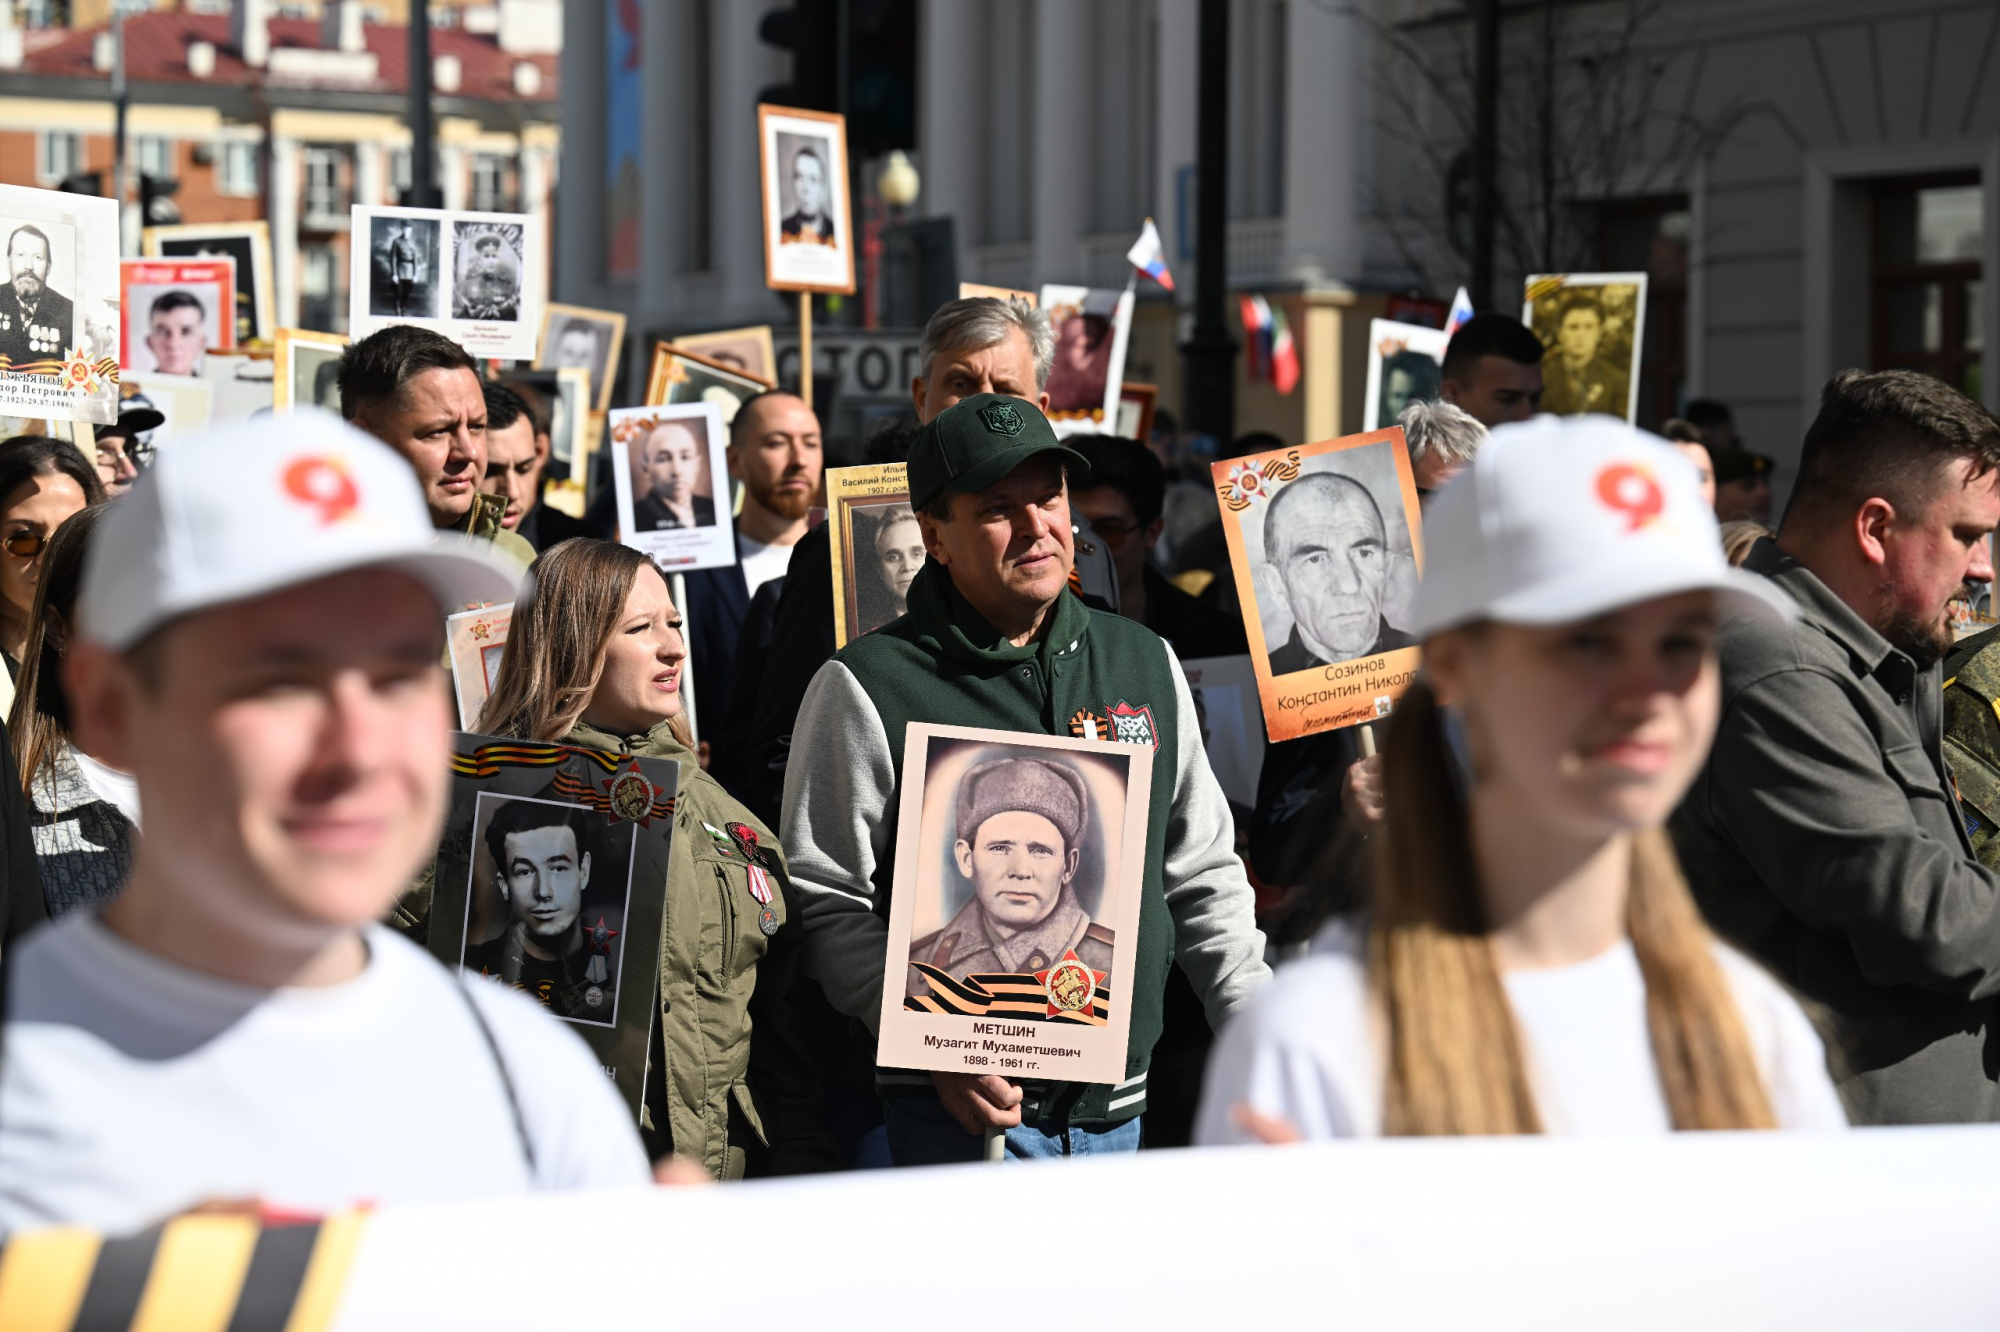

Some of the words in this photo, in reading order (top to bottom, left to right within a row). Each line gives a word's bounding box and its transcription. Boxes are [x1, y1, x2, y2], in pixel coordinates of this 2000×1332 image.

[22, 384, 76, 397] Петрович
[883, 466, 907, 474] Ильи
[842, 476, 879, 487] Василий
[881, 475, 909, 484] Конст
[868, 486, 885, 494] 1907
[893, 485, 910, 493] рож
[1324, 658, 1386, 682] Созинов
[1277, 686, 1362, 711] Константин
[973, 1022, 1036, 1038] МЕТШИН
[924, 1034, 979, 1050] Музагит
[982, 1039, 1081, 1058] Мухаметшевич
[963, 1055, 988, 1066] 1898
[999, 1058, 1023, 1069] 1961
[1026, 1061, 1040, 1070] гг.
